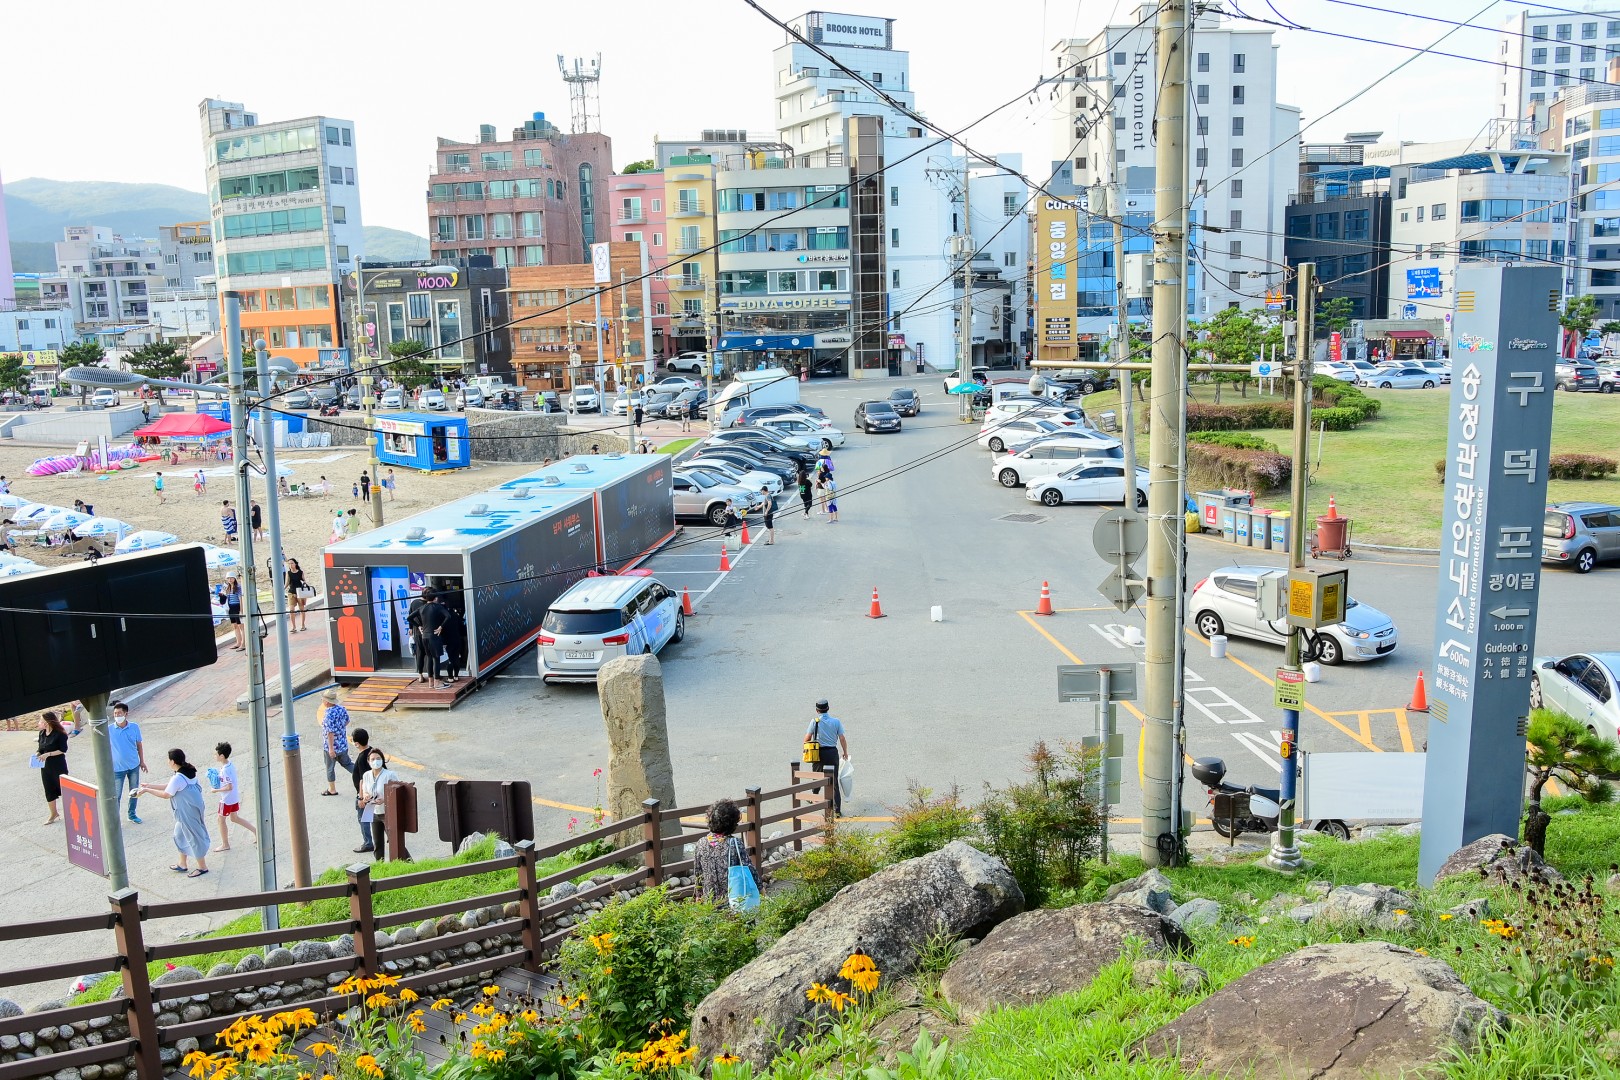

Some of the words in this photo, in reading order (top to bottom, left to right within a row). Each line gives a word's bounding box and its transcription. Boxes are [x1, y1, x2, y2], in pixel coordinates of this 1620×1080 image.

[826, 23, 857, 34] BROOKS
[858, 26, 883, 37] HOTEL
[1133, 51, 1148, 151] H.moment
[417, 277, 453, 289] MOON
[738, 299, 779, 310] EDIYA
[782, 297, 837, 309] COFFEE
[1496, 371, 1545, 559] 구덕포
[1446, 363, 1482, 631] 송정관광안내소
[1474, 487, 1484, 525] Center
[1469, 528, 1482, 594] Information
[1489, 572, 1536, 592] 광어골
[1466, 596, 1477, 635] Tourist
[380, 619, 390, 642] 남자
[1494, 623, 1515, 632] 1,000
[1450, 650, 1470, 668] 600m
[76, 834, 93, 850] 화장실
